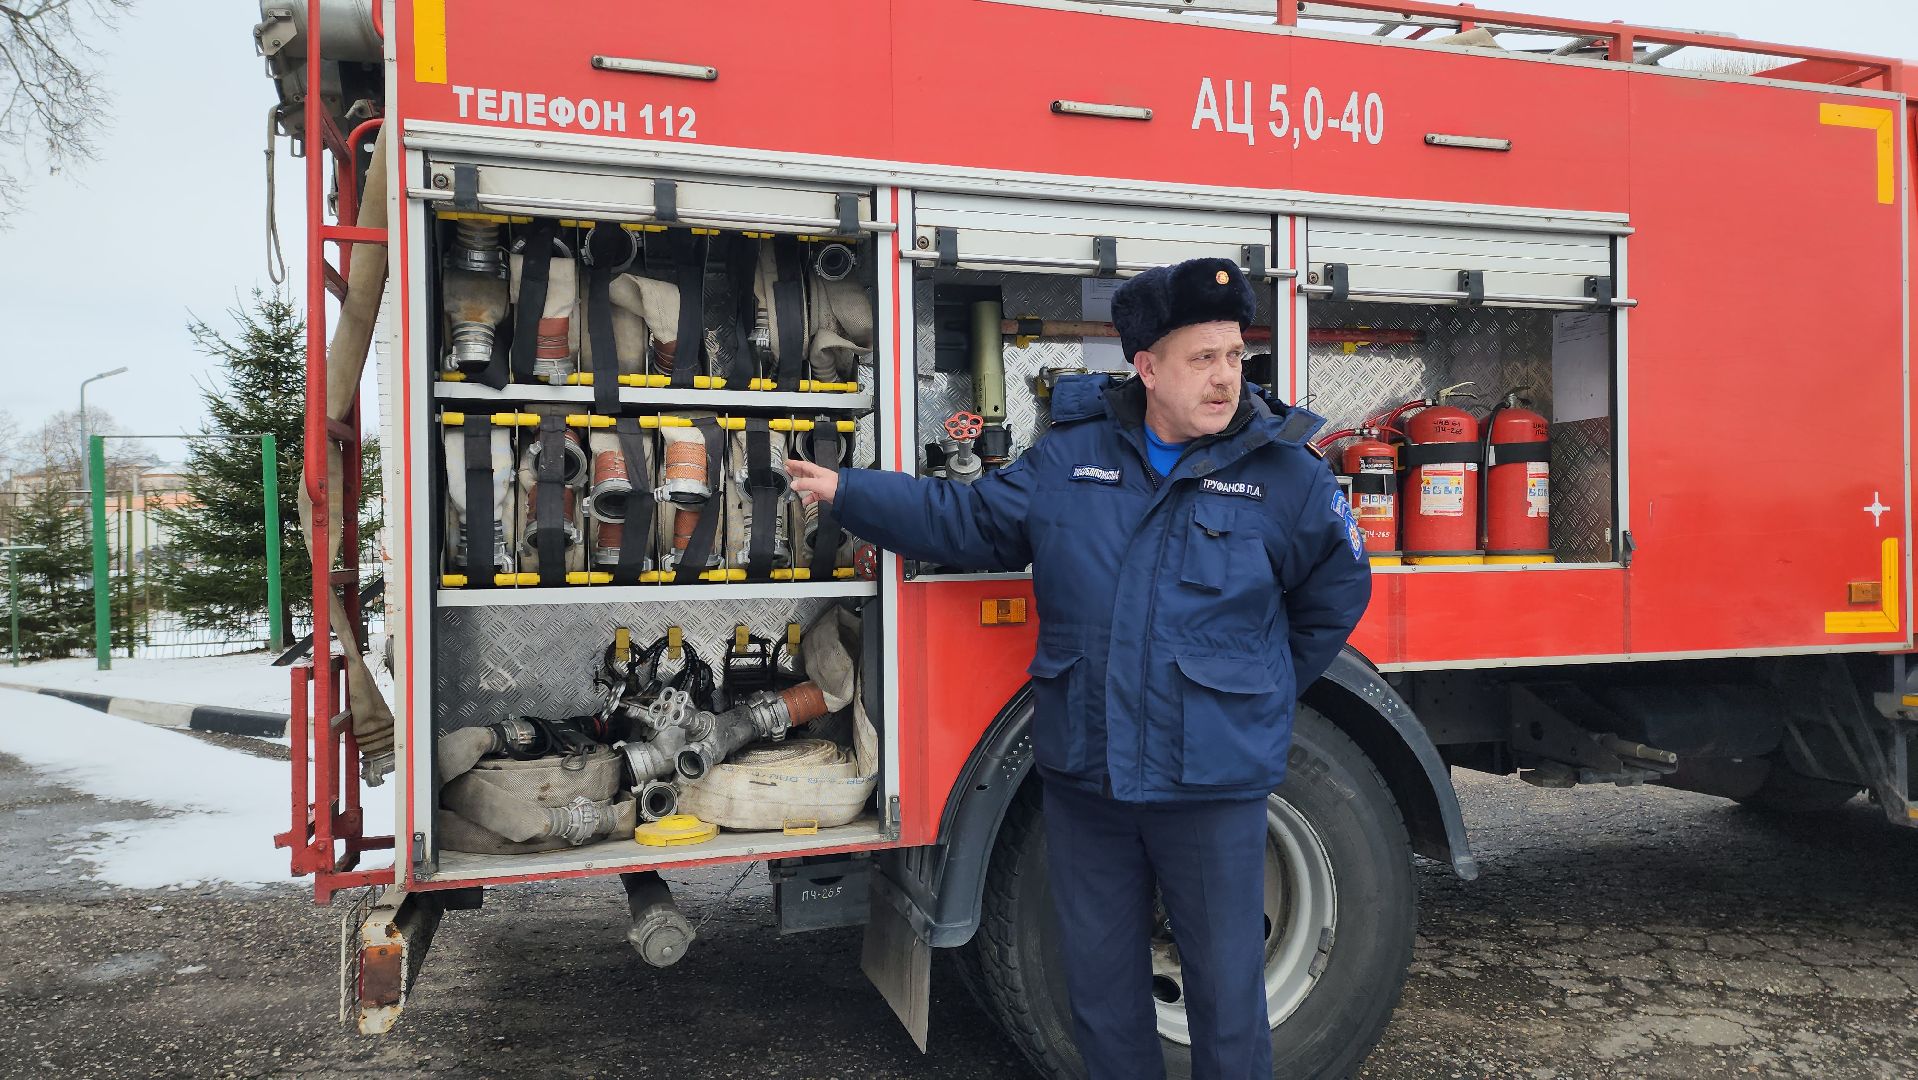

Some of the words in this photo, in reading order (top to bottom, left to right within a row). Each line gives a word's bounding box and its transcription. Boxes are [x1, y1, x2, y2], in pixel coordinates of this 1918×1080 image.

[452, 85, 626, 133] ТЕЛЕФОН
[639, 103, 698, 139] 112
[1191, 77, 1255, 146] АЦ
[1268, 84, 1384, 150] 5,0-40
[1203, 478, 1246, 493] ТРУФАНОВ
[1246, 484, 1262, 498] П.А.
[801, 886, 843, 903] ПЧ-265
